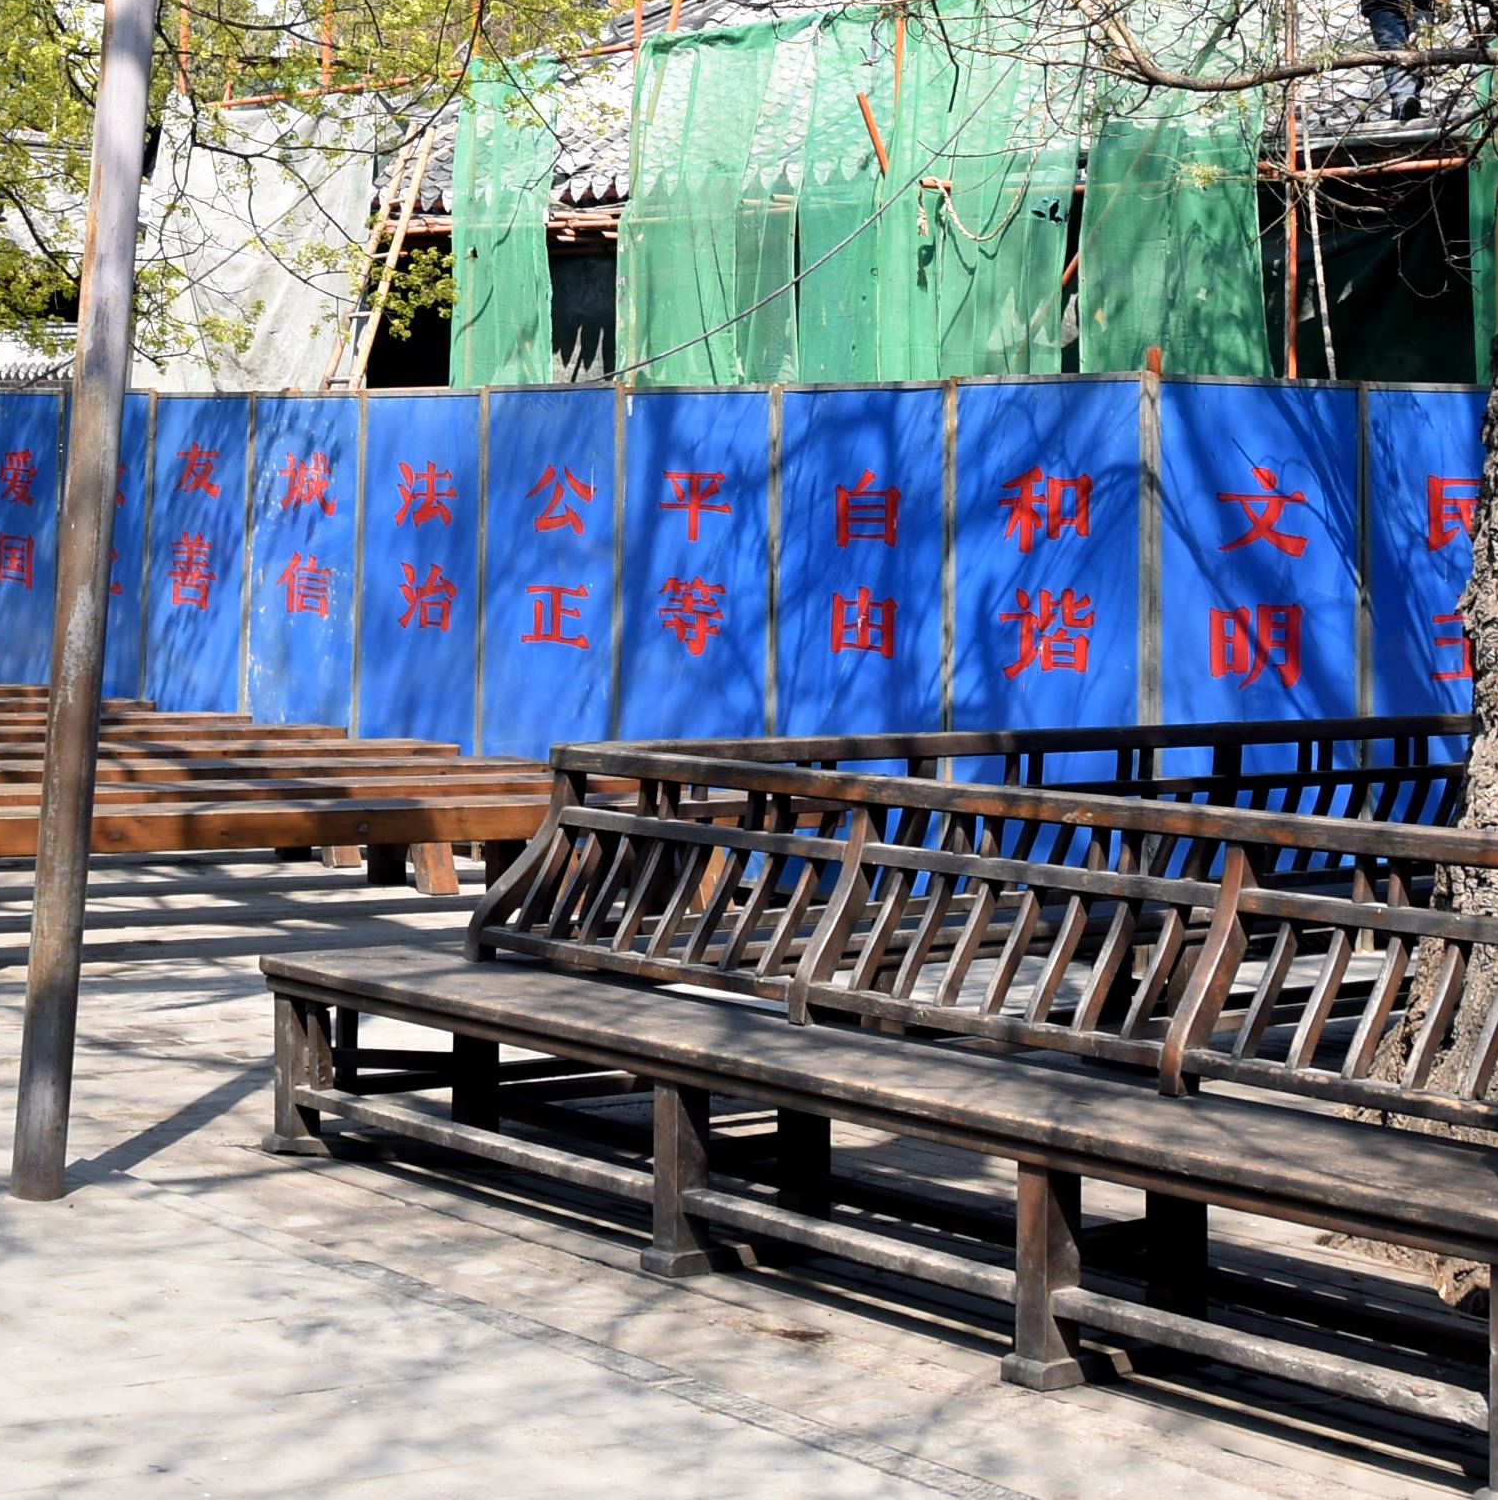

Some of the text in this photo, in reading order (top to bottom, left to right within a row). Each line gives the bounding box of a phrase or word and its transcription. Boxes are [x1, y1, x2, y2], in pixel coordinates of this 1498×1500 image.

[169, 442, 220, 610] 友善
[396, 461, 457, 632] 法治
[521, 465, 597, 649] 公正
[659, 471, 730, 656] 平等
[831, 469, 900, 660] 自由
[999, 466, 1095, 680] 和谐
[1210, 467, 1308, 689] 文明
